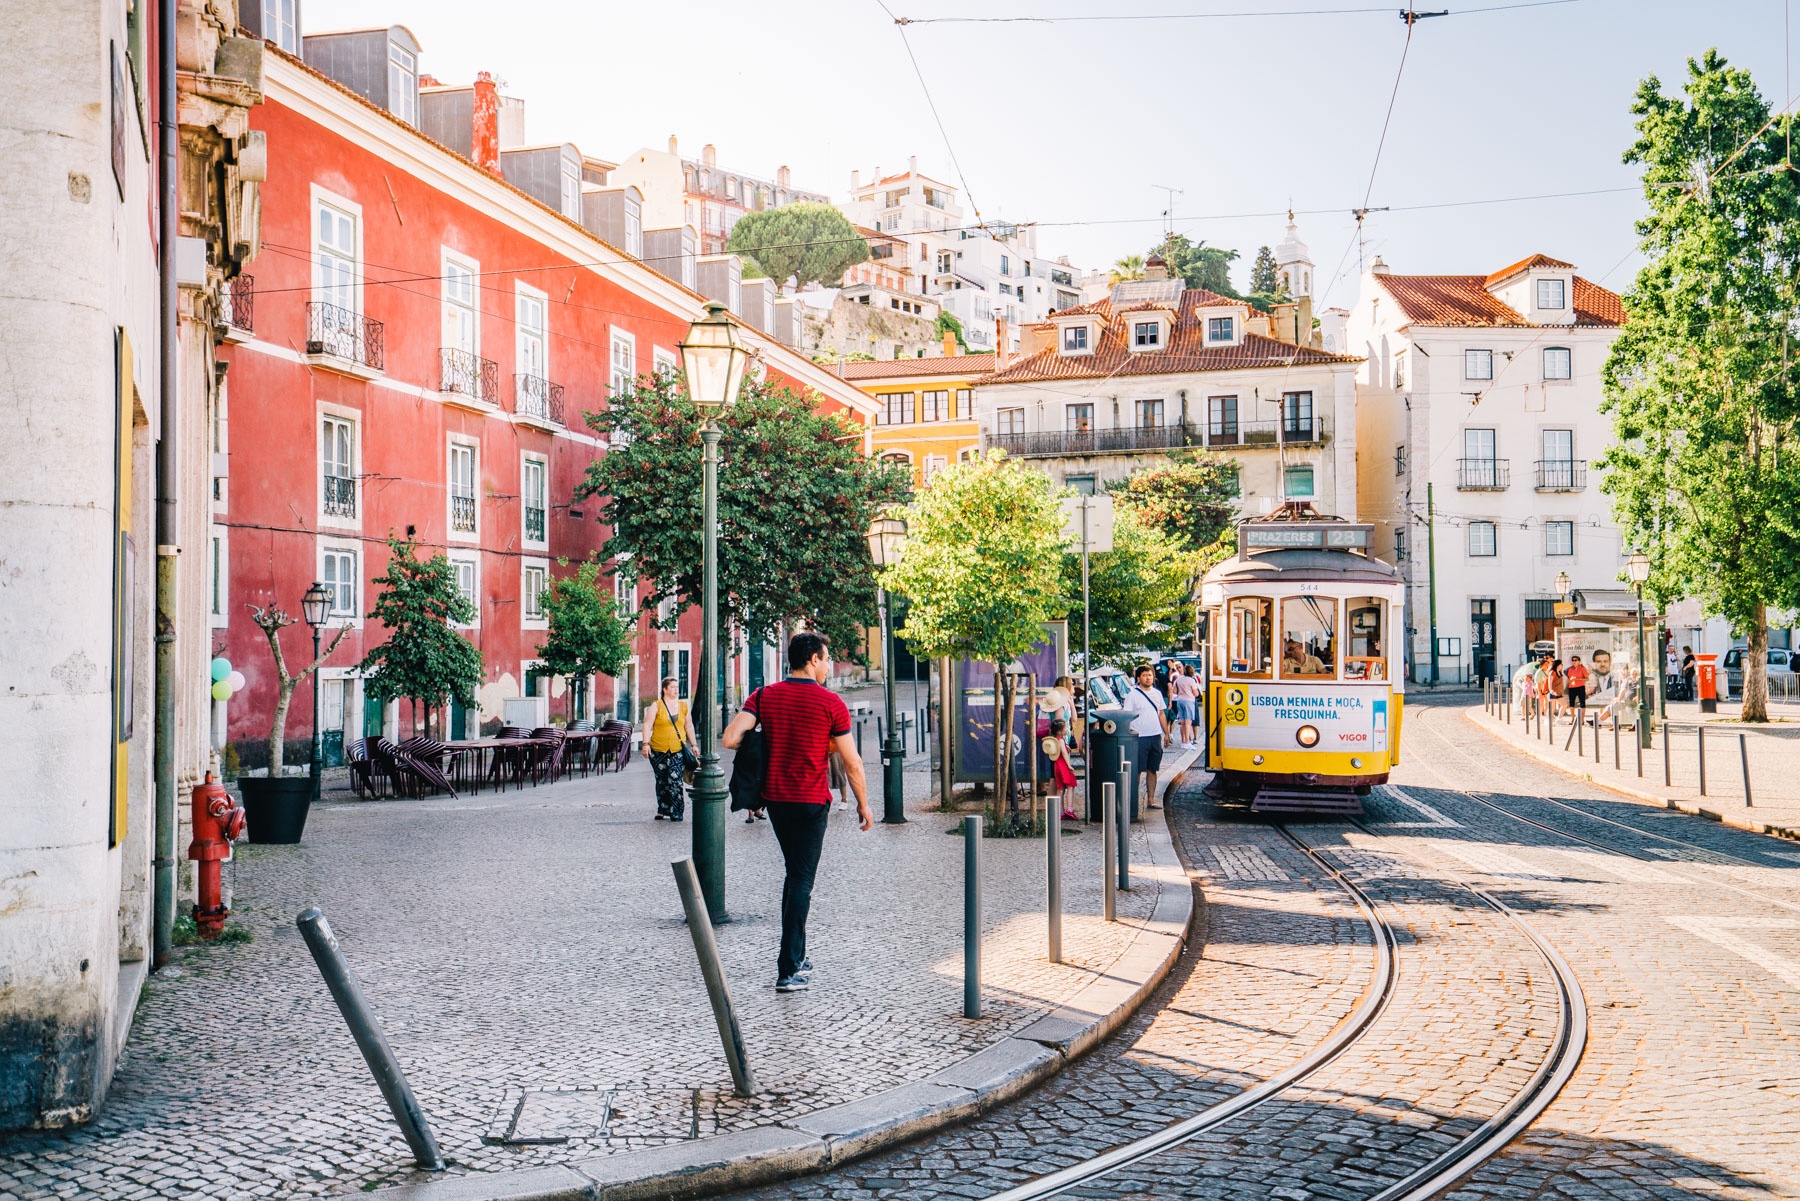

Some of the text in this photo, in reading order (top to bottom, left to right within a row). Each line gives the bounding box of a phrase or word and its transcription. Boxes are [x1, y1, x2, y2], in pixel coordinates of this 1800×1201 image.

[1250, 531, 1356, 545] PRAZERES 28
[1251, 696, 1363, 710] LISBOA MENINA E MOÇA,
[1274, 709, 1341, 720] FRESQUINHA.
[1339, 733, 1367, 742] VIGOR
